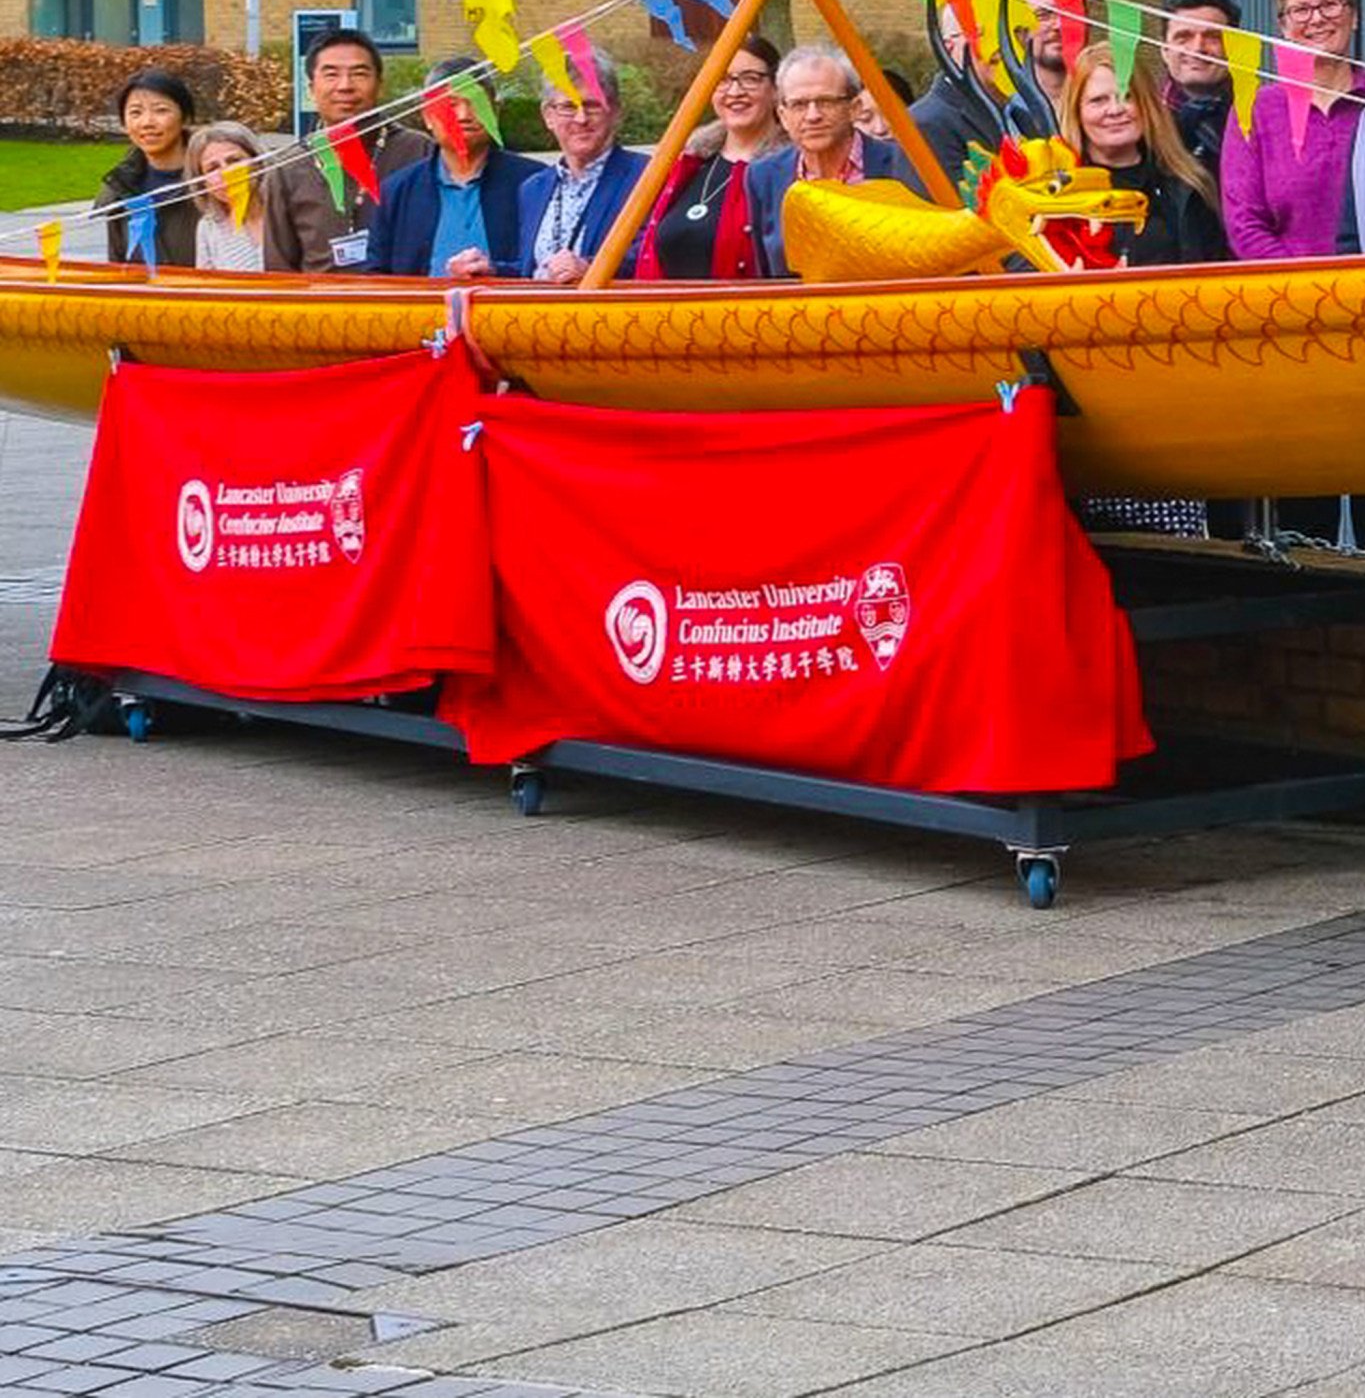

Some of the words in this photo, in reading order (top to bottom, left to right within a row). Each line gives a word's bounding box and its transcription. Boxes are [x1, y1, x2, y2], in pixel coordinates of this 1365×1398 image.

[216, 482, 275, 505] Lancaster
[275, 479, 337, 505] University
[218, 511, 278, 535] Confucius
[277, 510, 325, 533] Institute
[675, 585, 761, 610] Lancaster
[761, 575, 857, 607] University
[678, 618, 769, 645] Confucius
[771, 612, 843, 640] Institute
[671, 645, 859, 682] 兰卡斯特大学孔子学院
